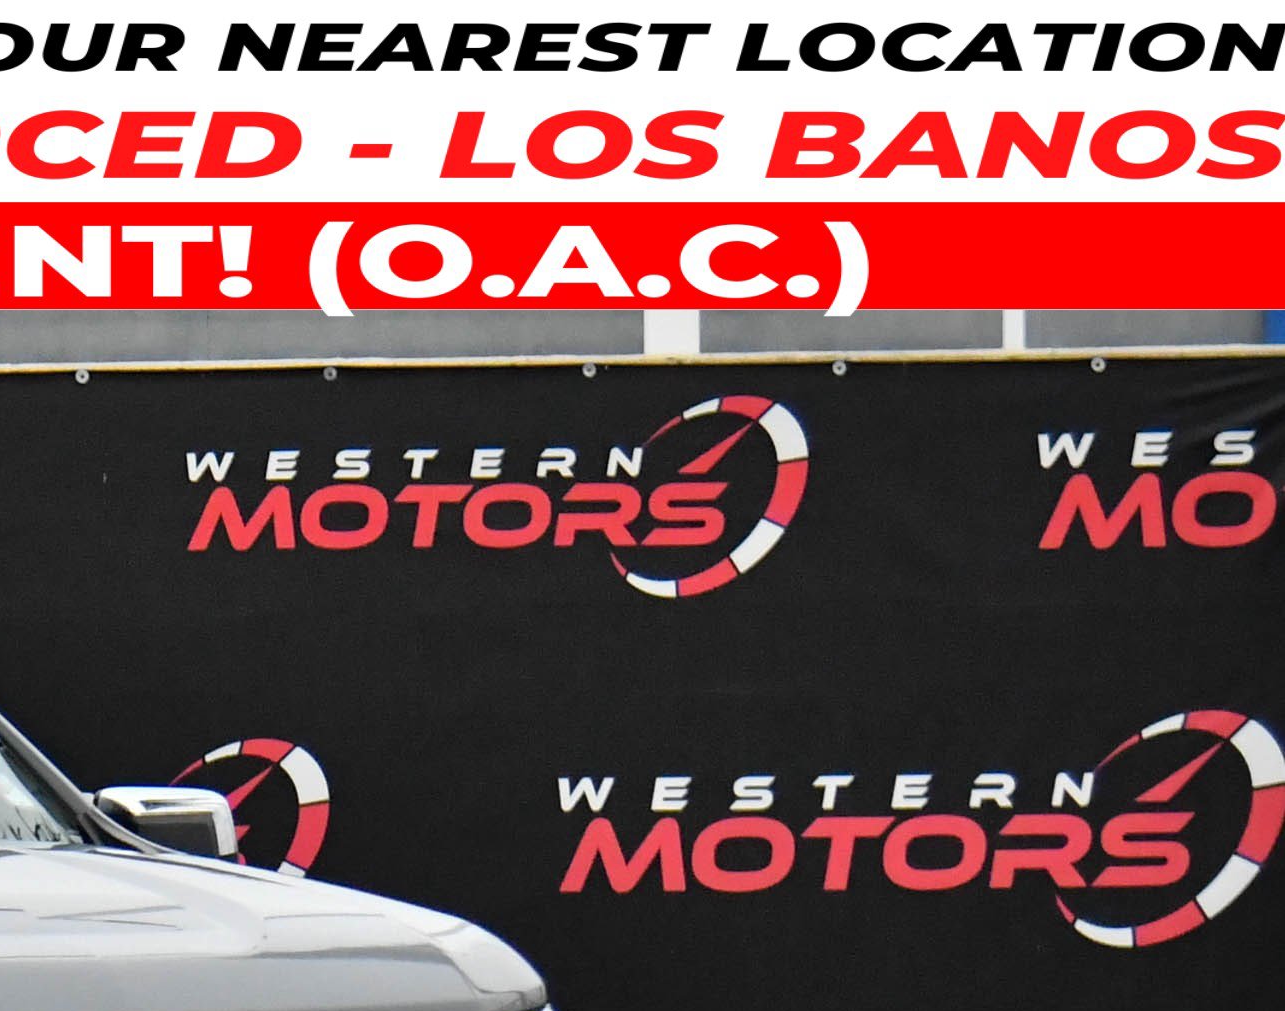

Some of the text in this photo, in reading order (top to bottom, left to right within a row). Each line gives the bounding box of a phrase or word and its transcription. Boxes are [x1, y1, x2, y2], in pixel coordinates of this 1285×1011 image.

[187, 448, 642, 481] WESTERN
[189, 483, 727, 550] MOTORS
[559, 773, 1093, 811] WESTERN
[561, 813, 1192, 893] MOTORS
